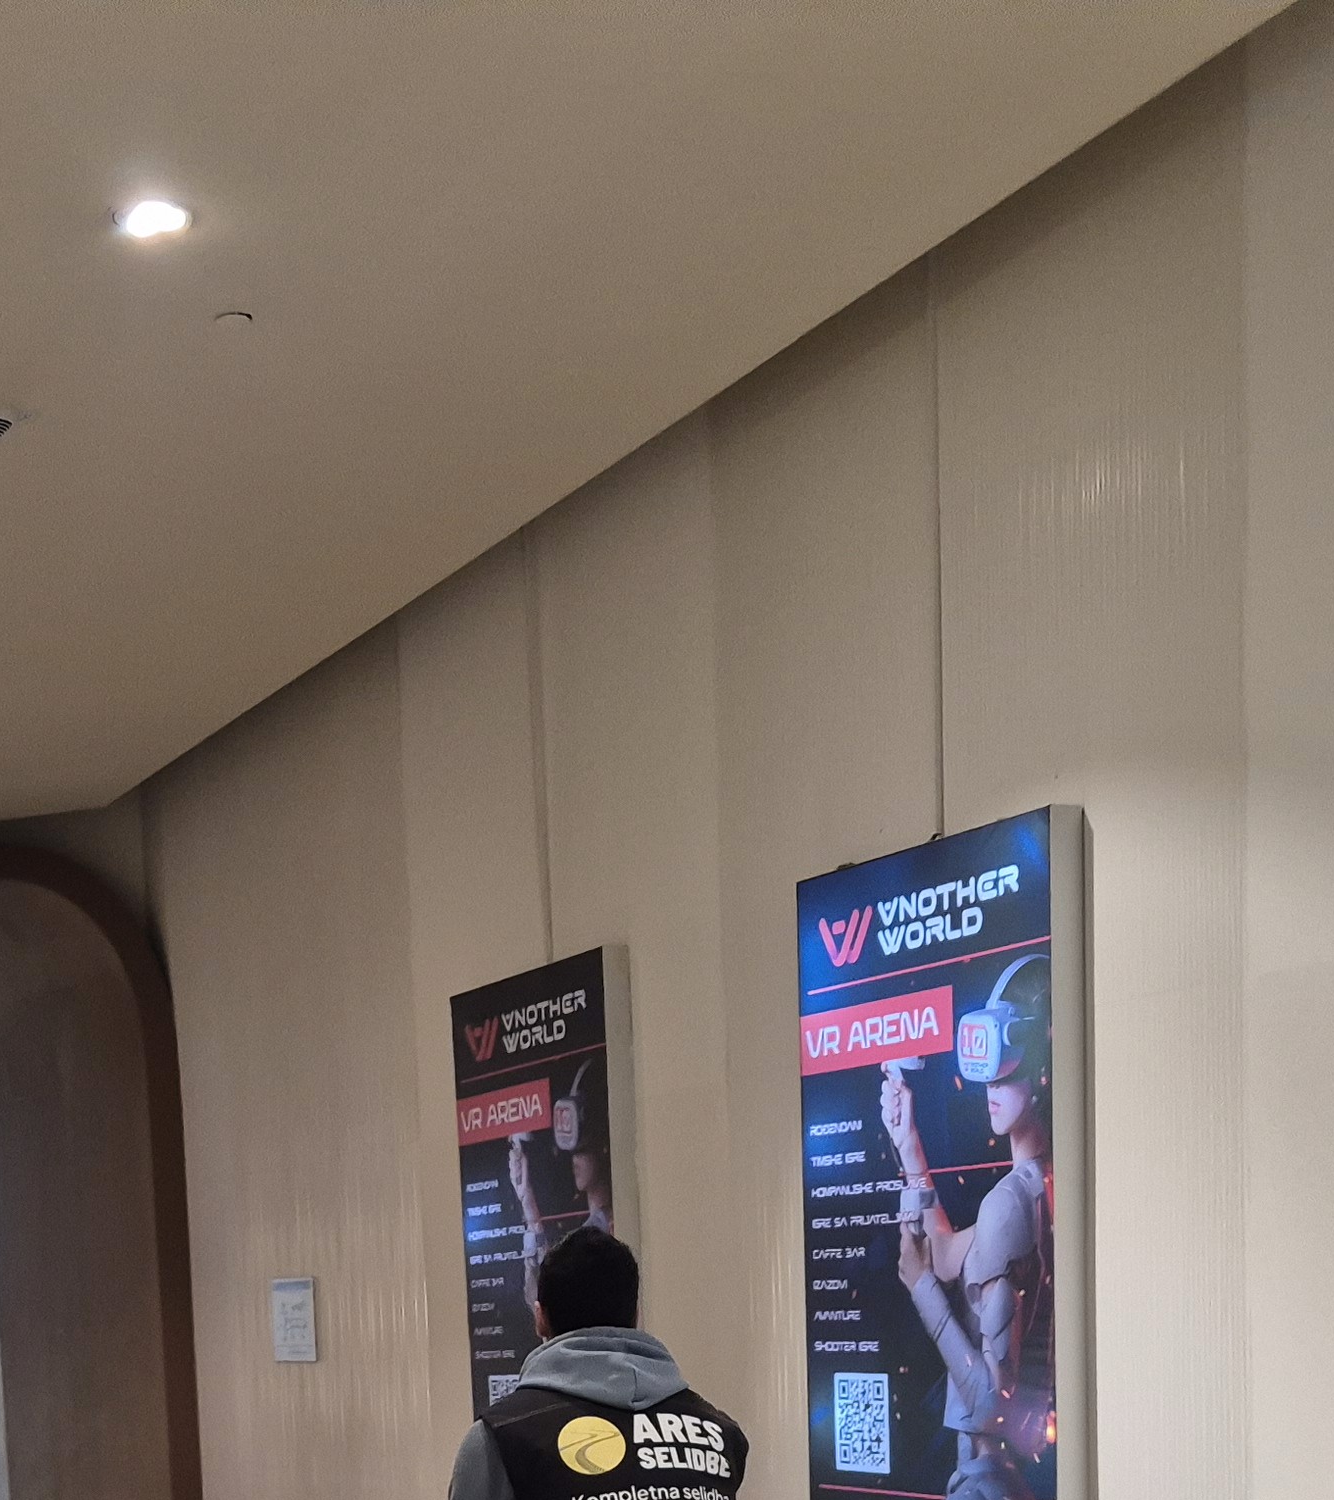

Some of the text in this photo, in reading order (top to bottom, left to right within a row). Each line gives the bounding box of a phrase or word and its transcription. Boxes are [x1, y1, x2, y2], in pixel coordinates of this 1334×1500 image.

[877, 906, 984, 956] WORLD
[502, 1018, 567, 1054] WORLD
[805, 1006, 940, 1059] VR ARENA
[460, 1107, 483, 1134] VR
[486, 1093, 543, 1125] ARENA
[633, 1412, 725, 1452] ARES
[637, 1446, 732, 1478] SELIDBE
